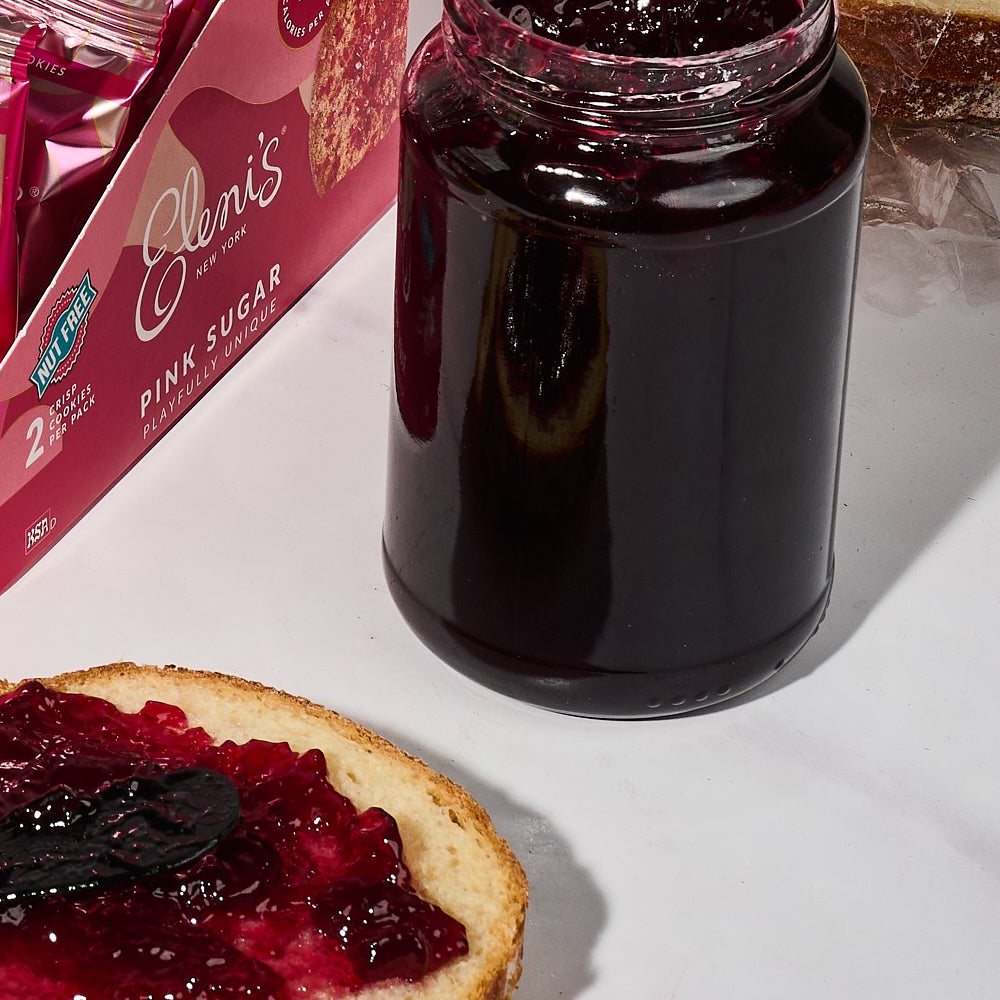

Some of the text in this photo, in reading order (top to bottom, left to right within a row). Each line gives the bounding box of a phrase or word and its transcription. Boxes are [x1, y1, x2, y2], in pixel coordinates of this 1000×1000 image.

[308, 10, 325, 33] PER
[195, 223, 249, 280] NEW YORK
[37, 285, 91, 386] NUT FREE
[140, 263, 282, 419] PINK SUGAR
[143, 298, 278, 440] PLAYFULLY UNIQUE
[49, 383, 77, 416] CRISP
[49, 383, 92, 431] COOKIES
[49, 394, 96, 446] PER PACK
[25, 416, 45, 469] 2
